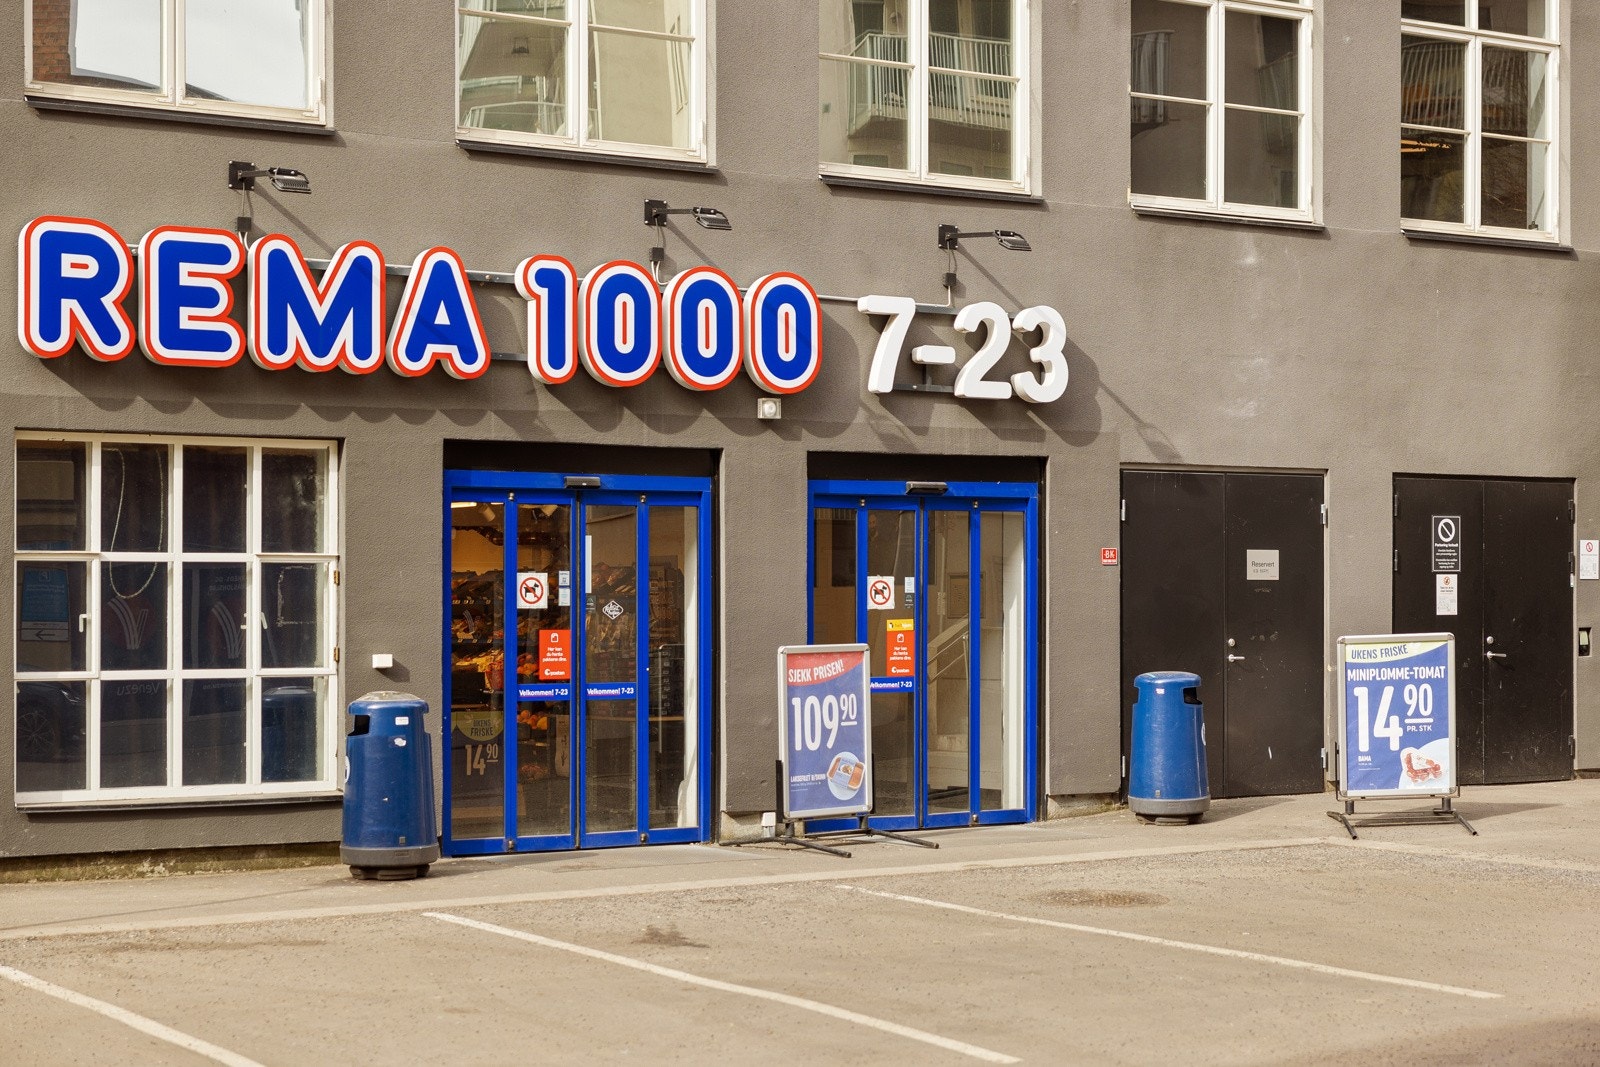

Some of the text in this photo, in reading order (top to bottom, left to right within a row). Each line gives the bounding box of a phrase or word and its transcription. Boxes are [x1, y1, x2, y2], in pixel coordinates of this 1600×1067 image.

[17, 214, 1070, 404] REMA 1000 7-23
[1251, 560, 1275, 568] Reservert
[1351, 644, 1409, 660] UKENS FRISKE
[788, 658, 845, 682] SJEKK PRISEN!
[1347, 665, 1446, 682] MINIPLOMME-TOMAT
[900, 680, 913, 688] 7-23
[555, 688, 568, 696] 7-23
[621, 687, 635, 695] 7-23
[1353, 685, 1404, 752] 14
[470, 727, 494, 736] FRISKE
[1419, 724, 1433, 732] STK
